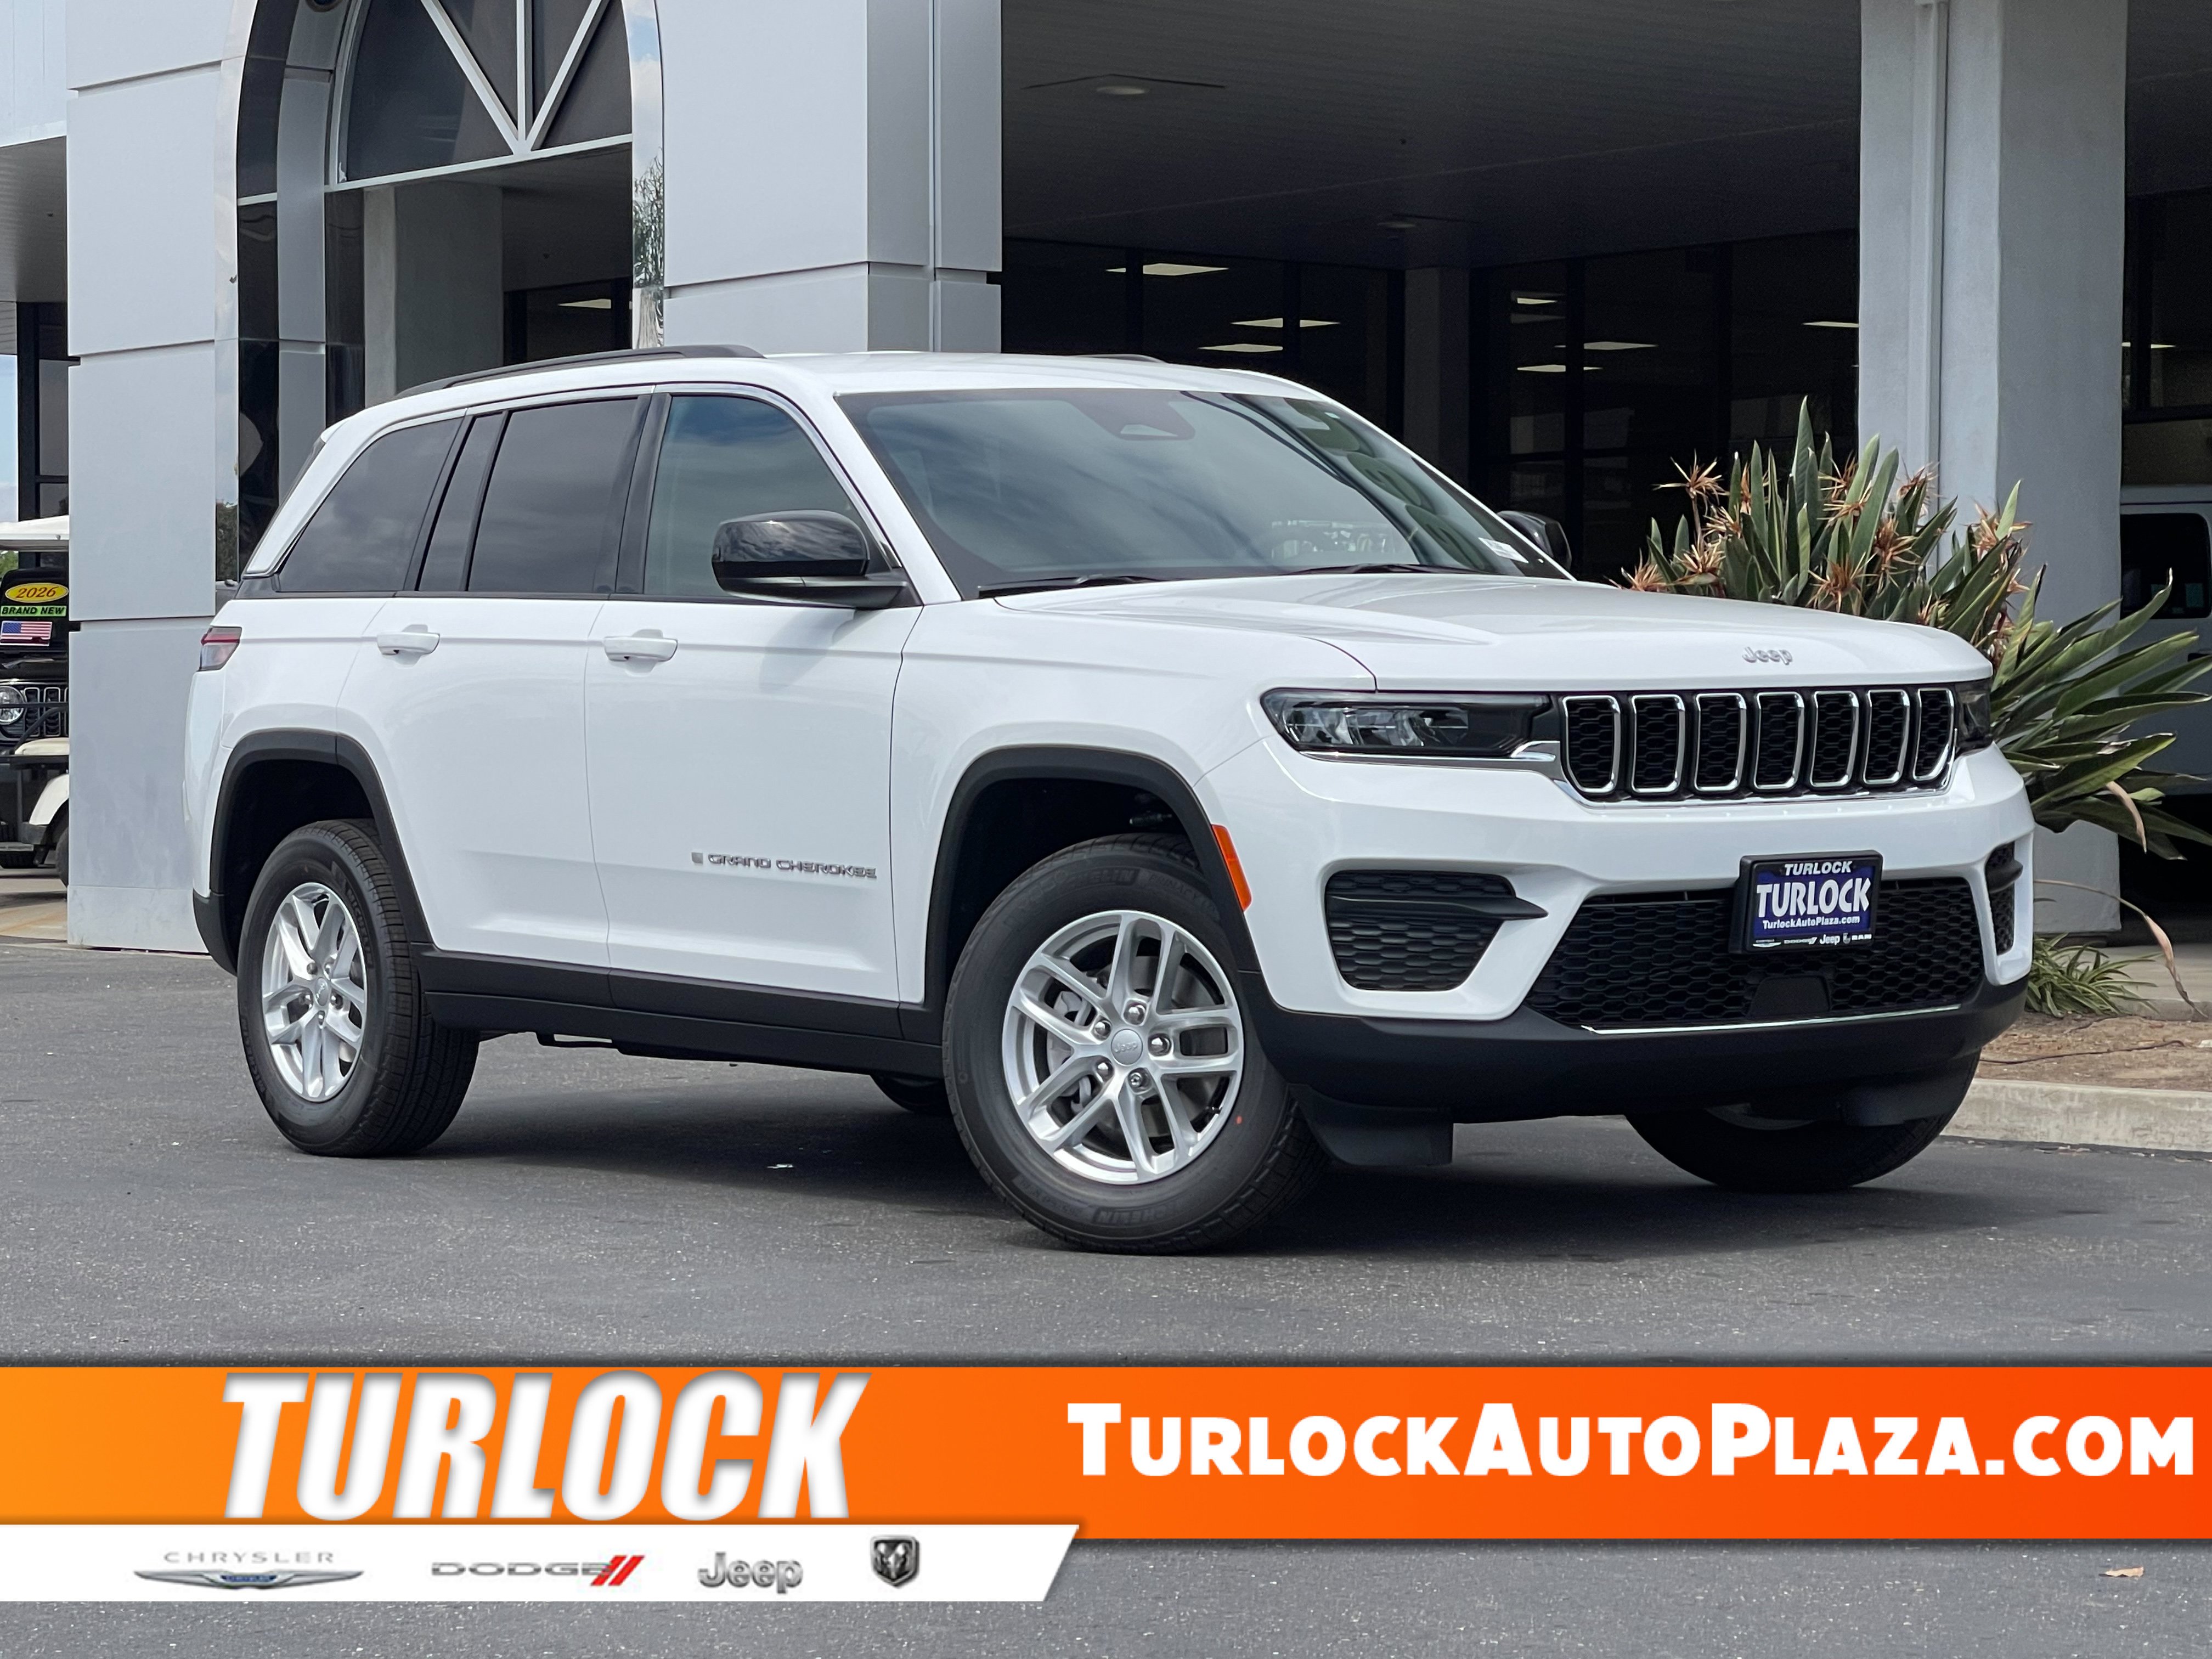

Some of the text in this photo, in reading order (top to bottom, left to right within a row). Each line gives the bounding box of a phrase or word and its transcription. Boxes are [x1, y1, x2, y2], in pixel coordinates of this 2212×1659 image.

[15, 586, 59, 599] 2026
[1741, 646, 1793, 665] Jeep
[708, 854, 877, 879] GRAND CHEROKEE
[1784, 861, 1853, 876] TURLOCK
[1757, 878, 1871, 918] TURLOCK
[1762, 916, 1860, 929] TurlockAutoPlaza.com
[1820, 934, 1841, 945] Jeep
